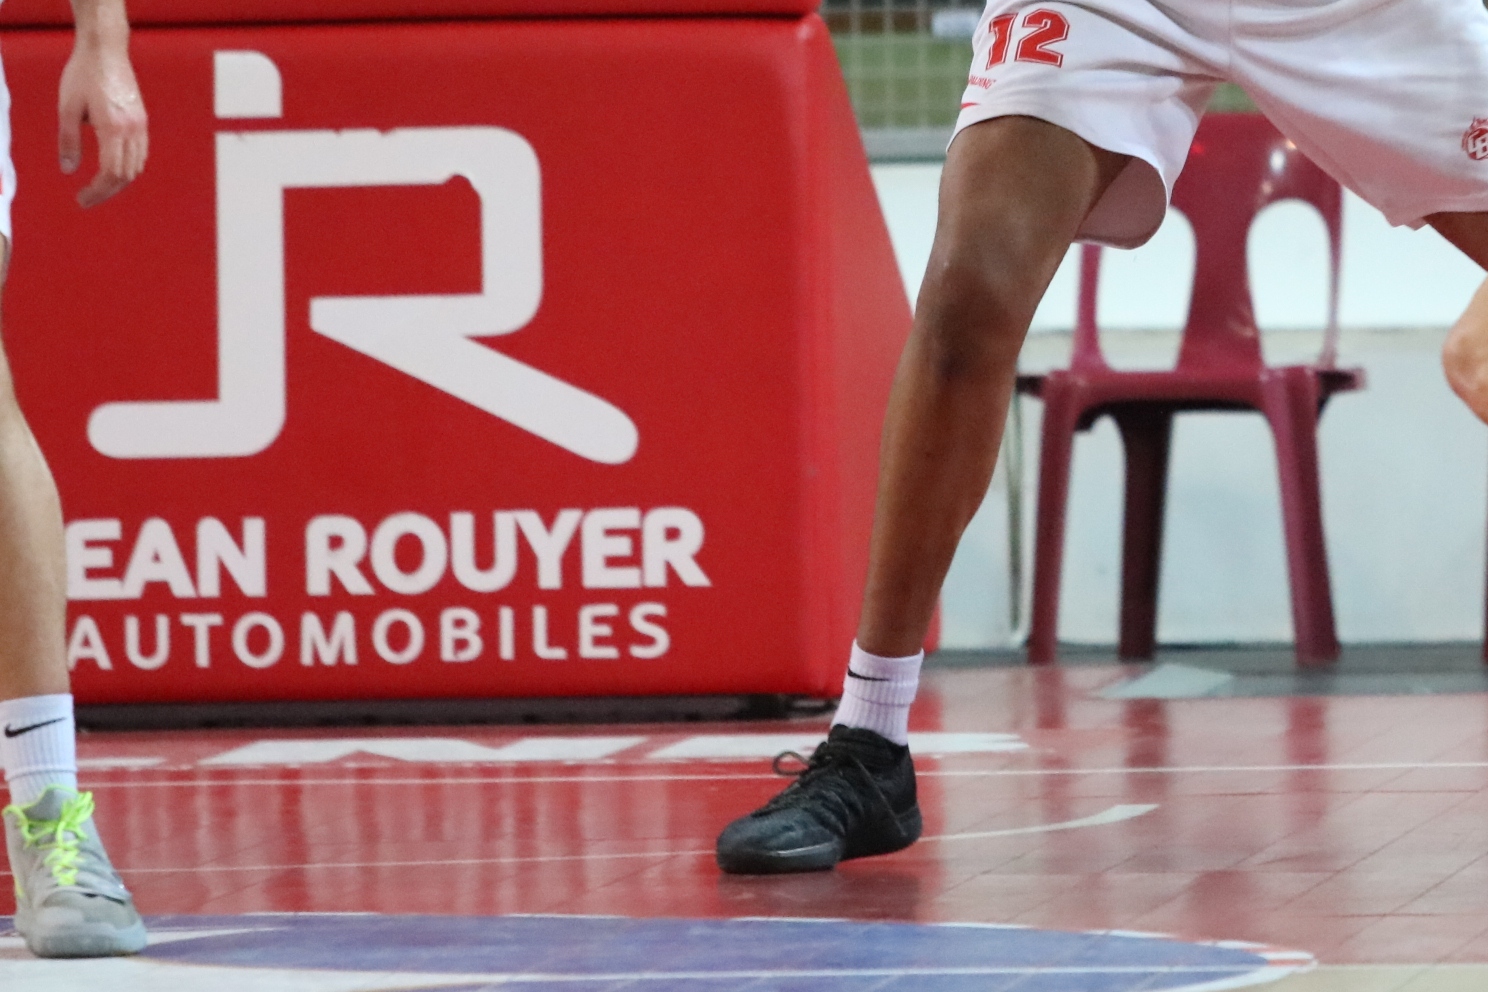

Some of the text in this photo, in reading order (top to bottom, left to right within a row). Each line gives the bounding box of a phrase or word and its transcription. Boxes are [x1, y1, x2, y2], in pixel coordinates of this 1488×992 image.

[985, 8, 1070, 71] 12
[63, 506, 712, 600] EAN ROUYER
[66, 602, 672, 672] AUTOMOBILES
